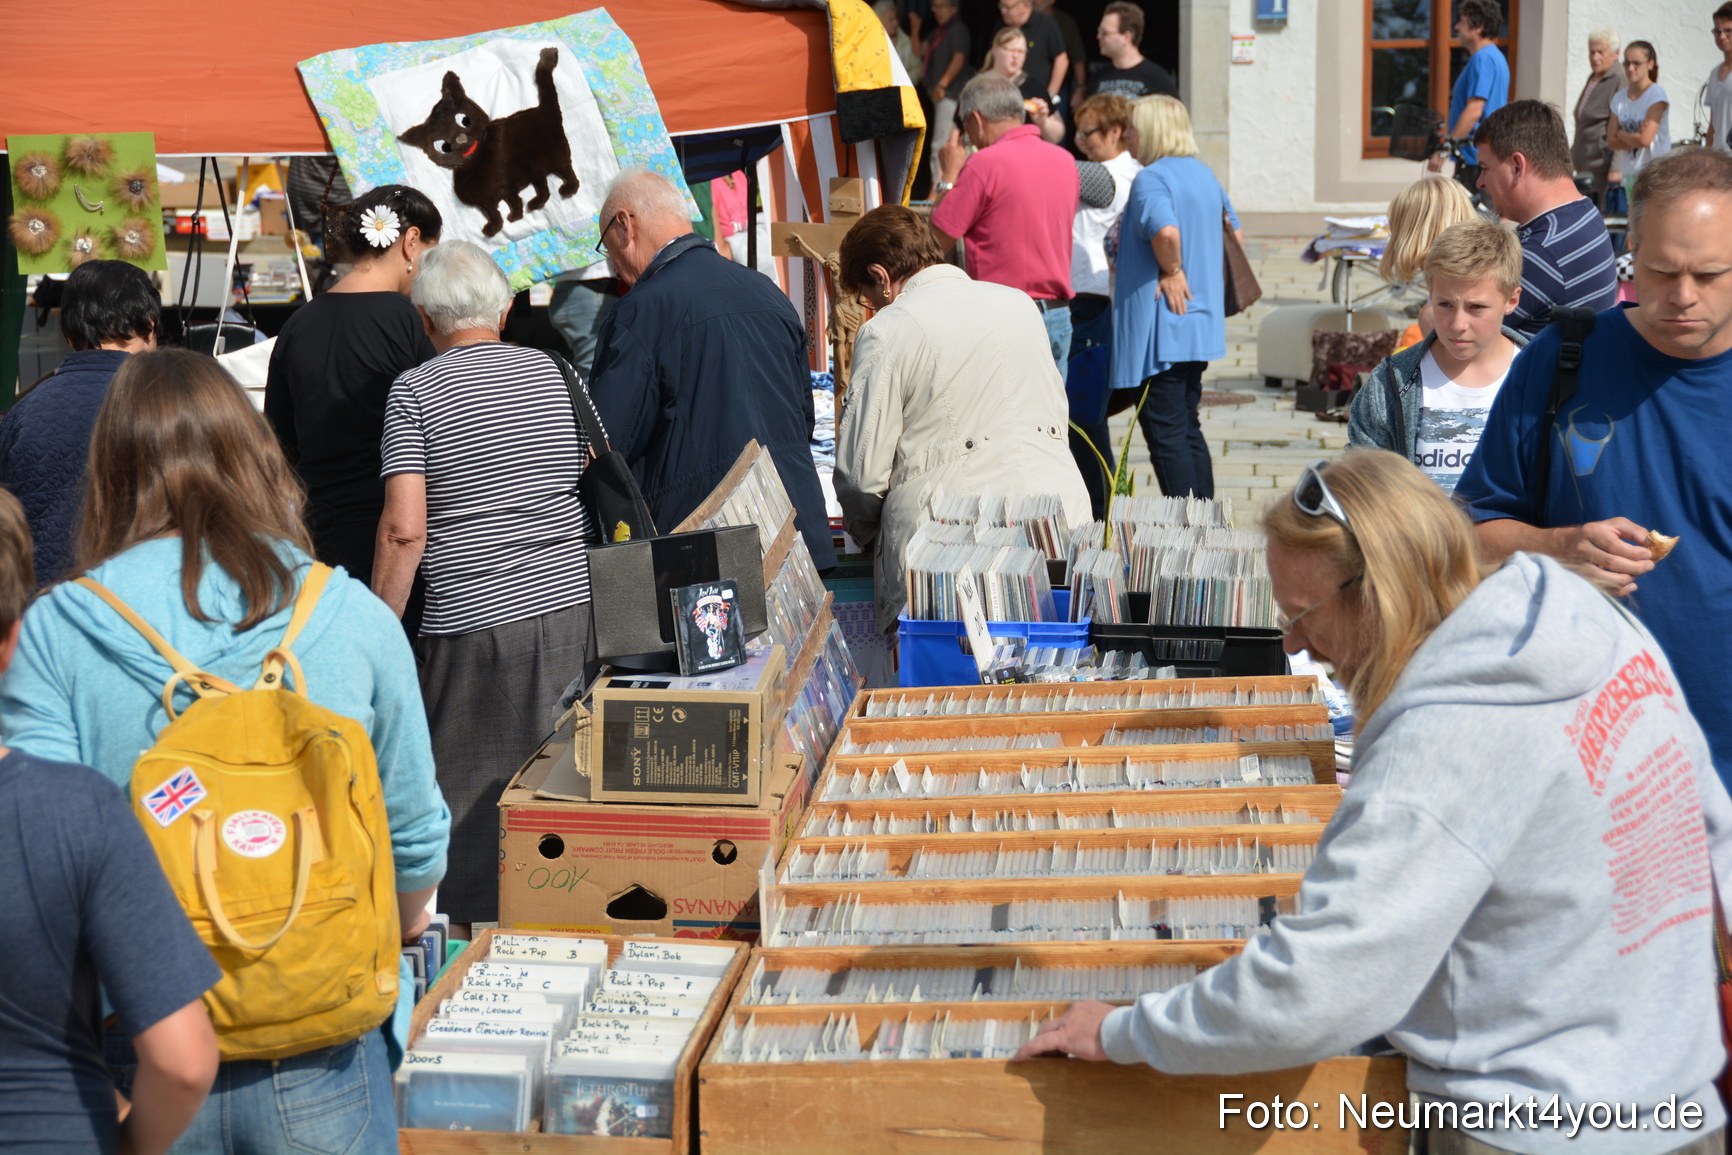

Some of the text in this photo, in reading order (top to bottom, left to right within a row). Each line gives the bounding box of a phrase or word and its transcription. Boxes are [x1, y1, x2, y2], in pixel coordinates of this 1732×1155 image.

[632, 747, 642, 786] SONY
[495, 945, 515, 955] Rock
[529, 947, 547, 958] Pop
[566, 950, 577, 959] B
[627, 948, 681, 960] Dylan, Bob
[466, 976, 491, 987] Rock
[503, 978, 523, 990] Pop
[609, 976, 632, 986] Rock
[648, 978, 665, 990] Pop
[405, 1053, 443, 1064] Doors
